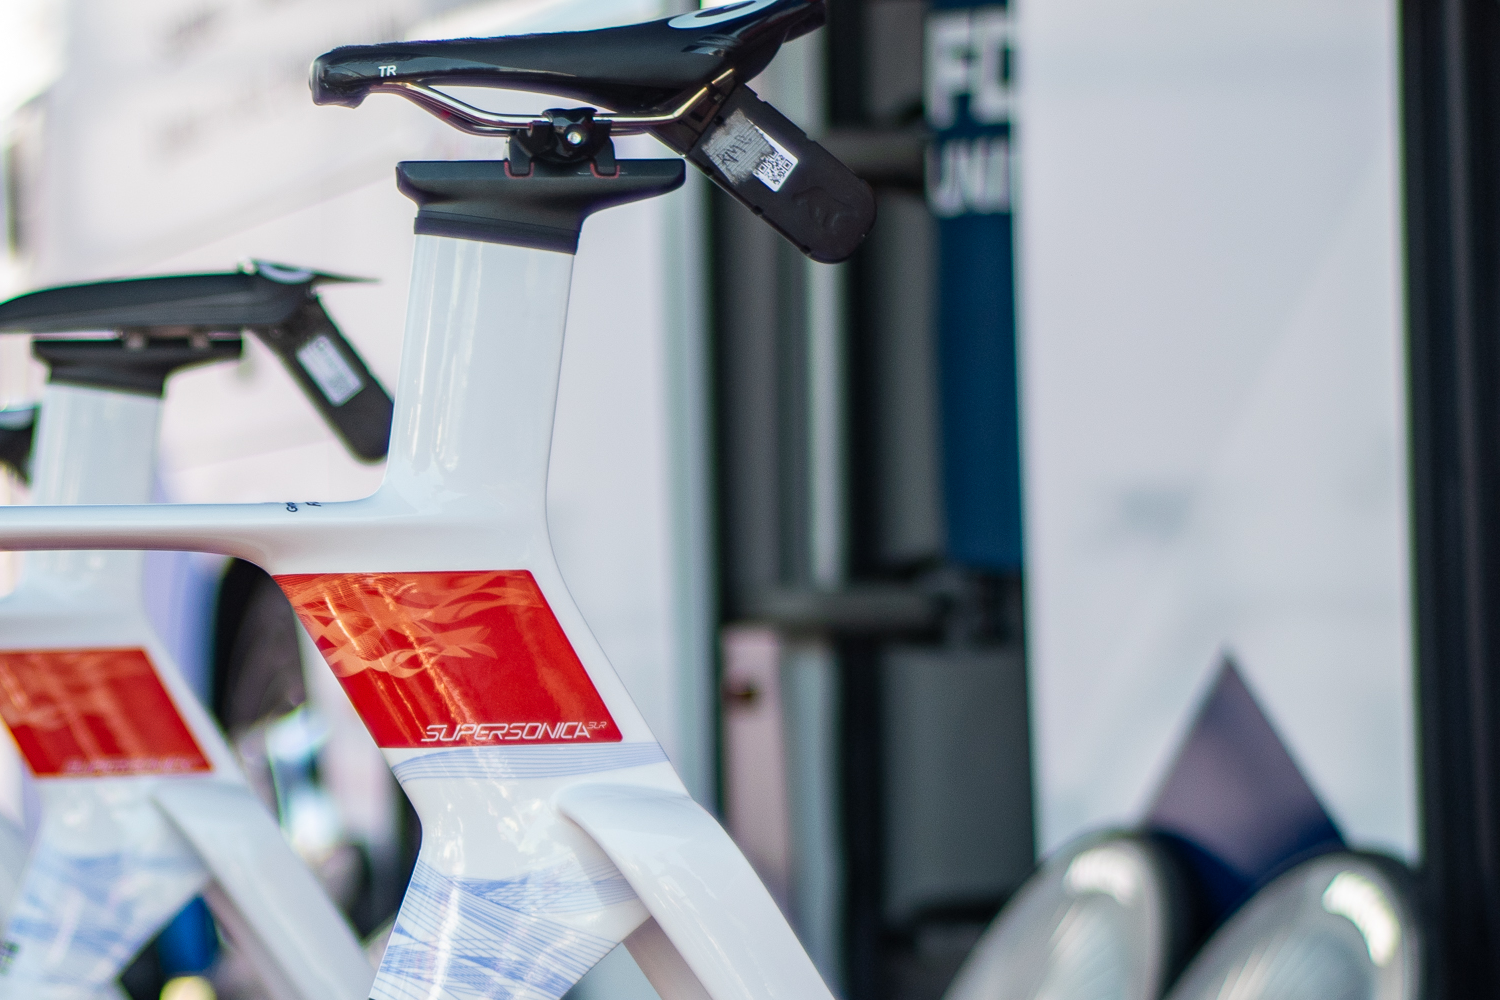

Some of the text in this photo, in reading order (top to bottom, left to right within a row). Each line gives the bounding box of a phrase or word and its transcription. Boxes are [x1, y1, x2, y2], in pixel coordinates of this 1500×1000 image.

[378, 65, 397, 77] TR
[421, 721, 607, 742] SUPERSONICA SLR
